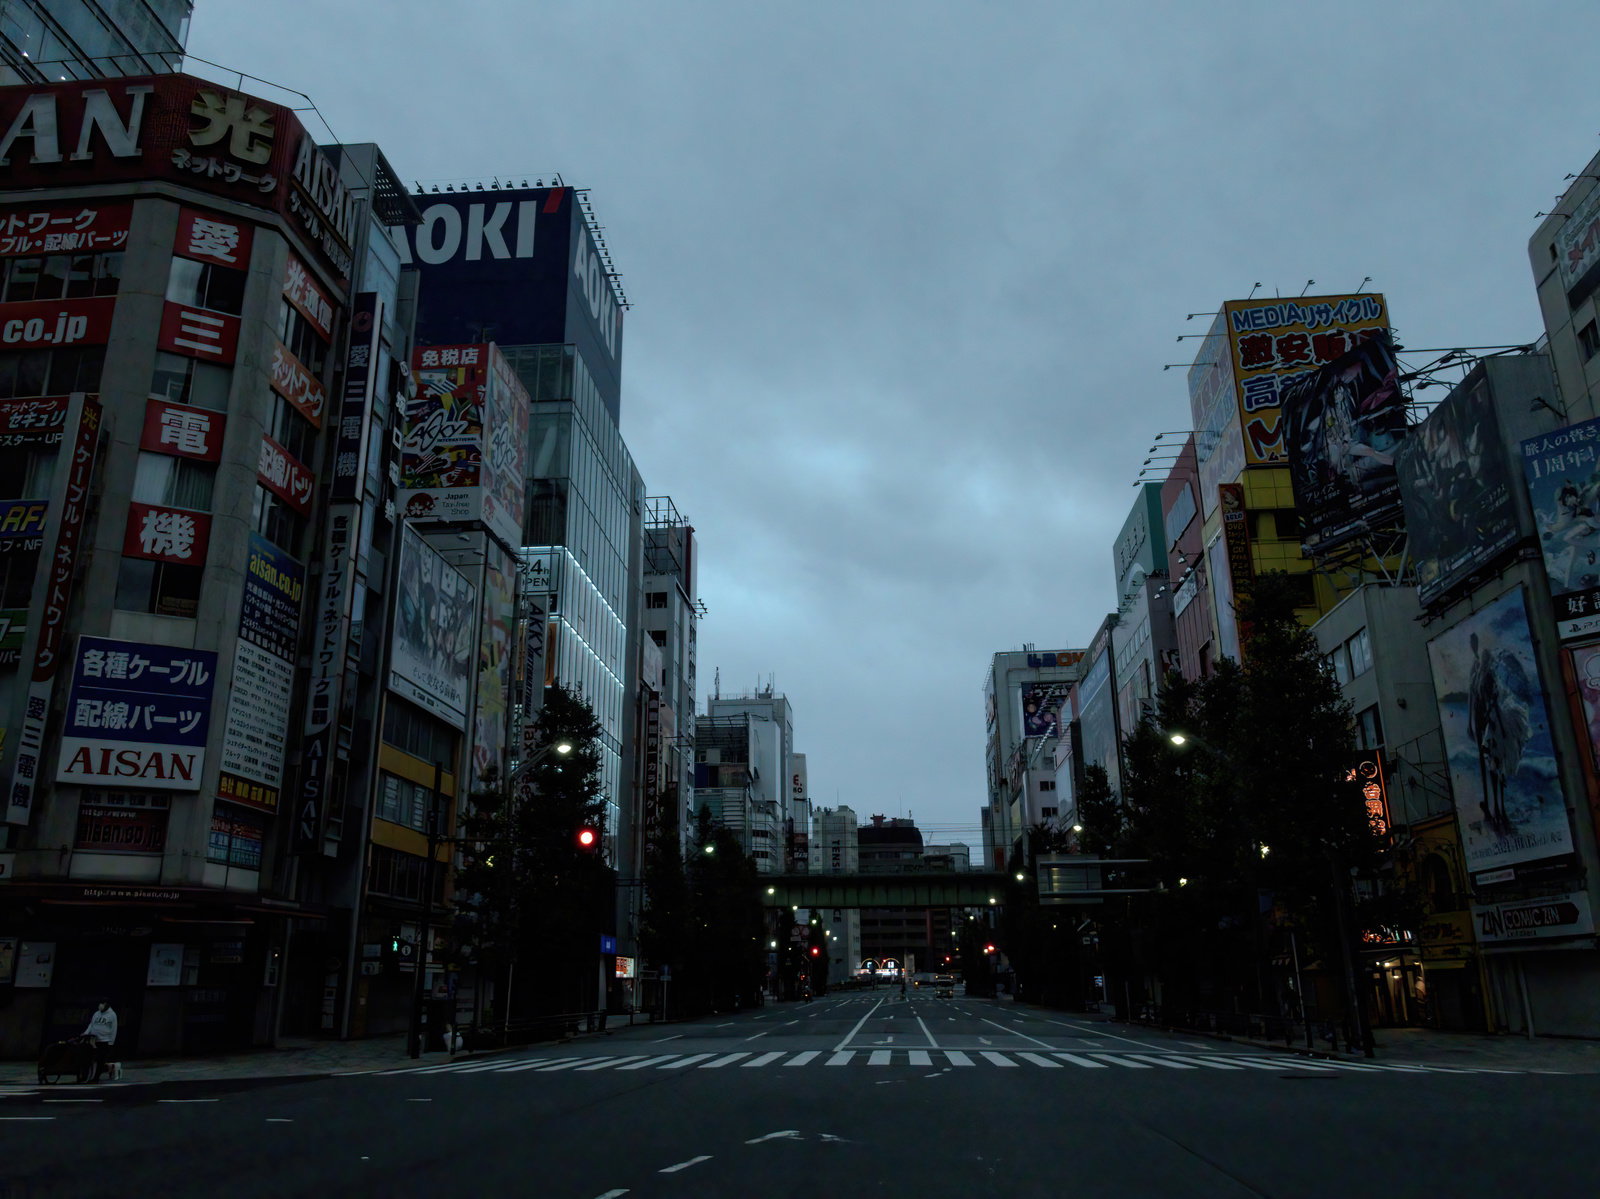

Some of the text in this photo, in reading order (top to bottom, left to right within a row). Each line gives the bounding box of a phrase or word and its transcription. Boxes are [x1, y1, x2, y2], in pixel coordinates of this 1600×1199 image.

[188, 88, 276, 165] 光
[170, 147, 278, 194] ネットワーク
[293, 130, 355, 253] AISAN
[0, 208, 98, 236] トワーク
[188, 216, 241, 264] 愛
[574, 224, 617, 361] AOKI
[1232, 297, 1382, 332] MEDIAリサイクル
[2, 311, 88, 344] co.jp
[173, 310, 226, 356] 三
[421, 347, 480, 367] 免税店
[272, 348, 326, 420] ネットワーク
[159, 407, 212, 456] 電
[336, 344, 369, 477] 愛三電機
[258, 442, 313, 504] 配線パーツ
[37, 405, 99, 667] 光・ケーブル・ネットワーク
[140, 508, 196, 560] 機
[250, 554, 302, 601] aisan.co.jp
[529, 602, 544, 658] AKKY
[82, 648, 210, 687] 各種ケーブル
[73, 698, 203, 735] 配線パーツ
[12, 697, 46, 808] 愛三電機
[65, 746, 196, 781] AISAN
[302, 739, 324, 841] AISAN
[1504, 904, 1560, 929] COMIC ZIN
